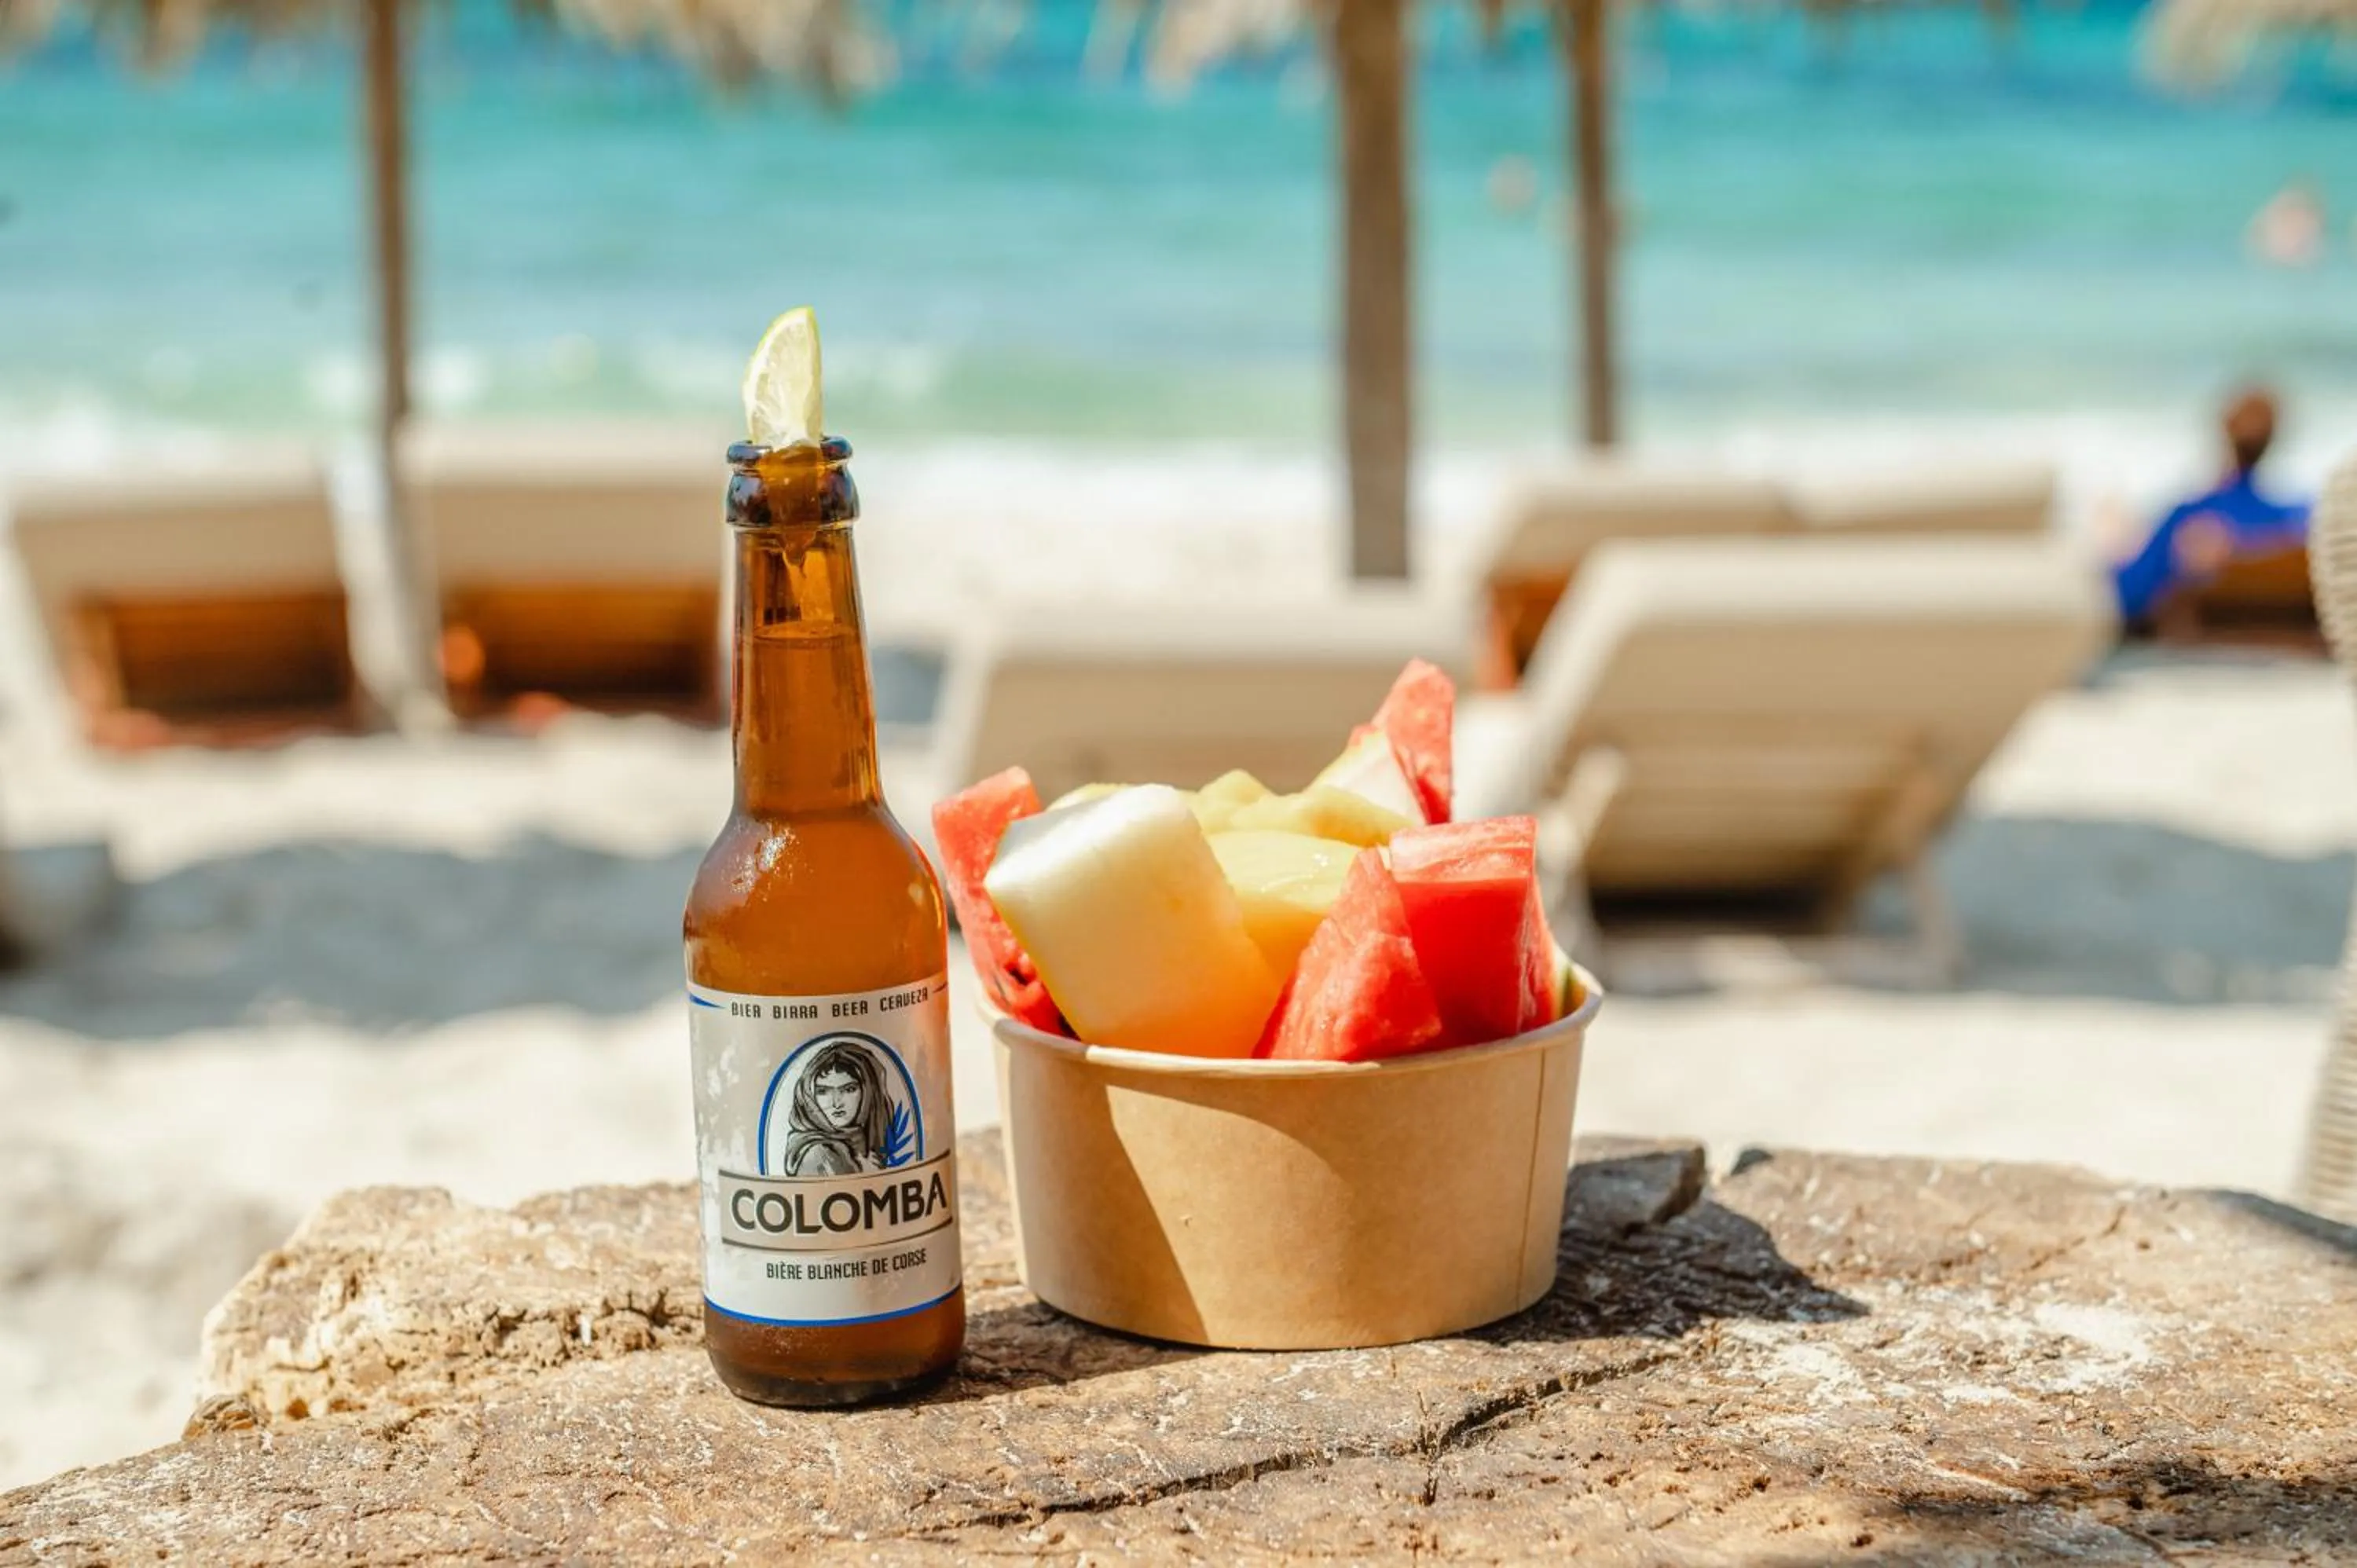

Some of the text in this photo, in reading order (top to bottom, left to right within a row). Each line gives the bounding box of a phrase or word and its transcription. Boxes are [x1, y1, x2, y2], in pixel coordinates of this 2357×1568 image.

[731, 987, 928, 1019] BIER BIRRA BEER CERVEZA
[731, 1171, 948, 1234] COLOMBA
[766, 1248, 927, 1280] BIÈRE BLANCHE DE CORSE
